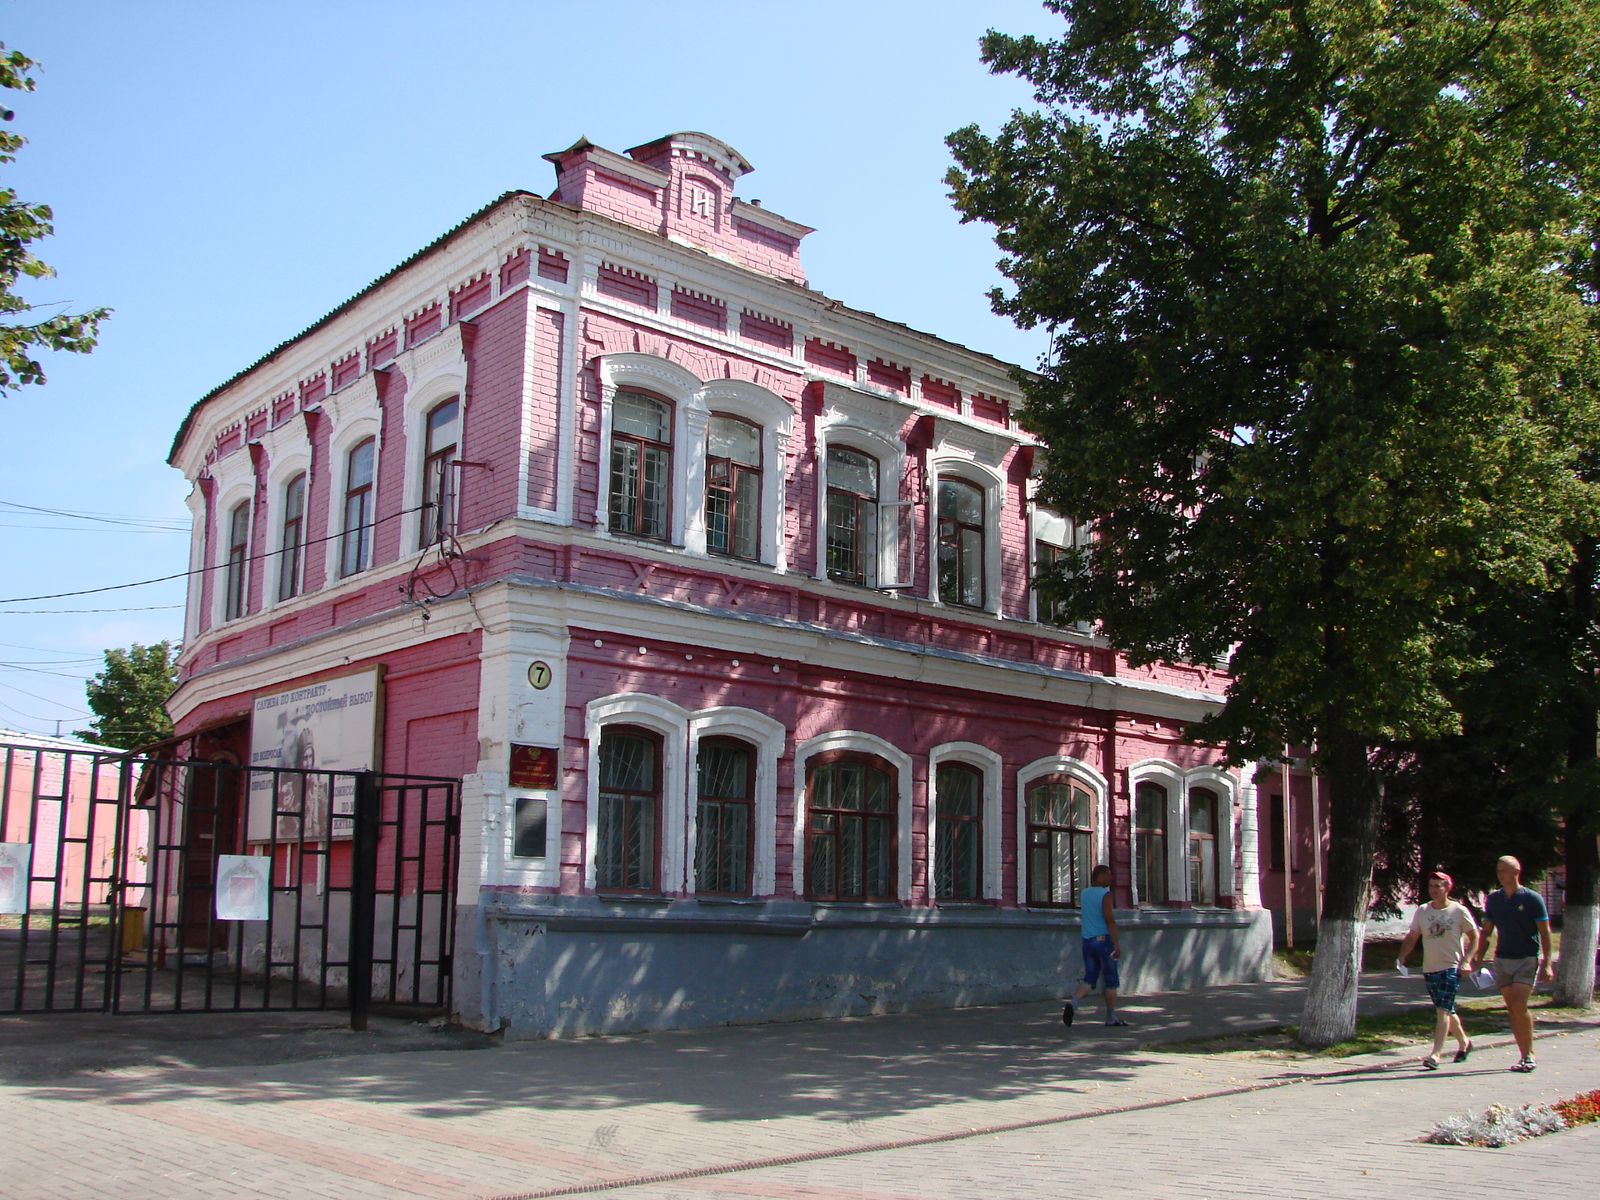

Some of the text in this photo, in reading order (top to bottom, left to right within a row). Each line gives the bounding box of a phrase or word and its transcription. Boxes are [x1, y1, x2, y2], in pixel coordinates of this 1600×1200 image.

[536, 666, 545, 683] 7
[256, 698, 279, 711] СЛУЖБА
[280, 694, 289, 706] ПО
[290, 684, 327, 702] КОНТРАКТУ
[349, 690, 374, 706] ВЫБОР
